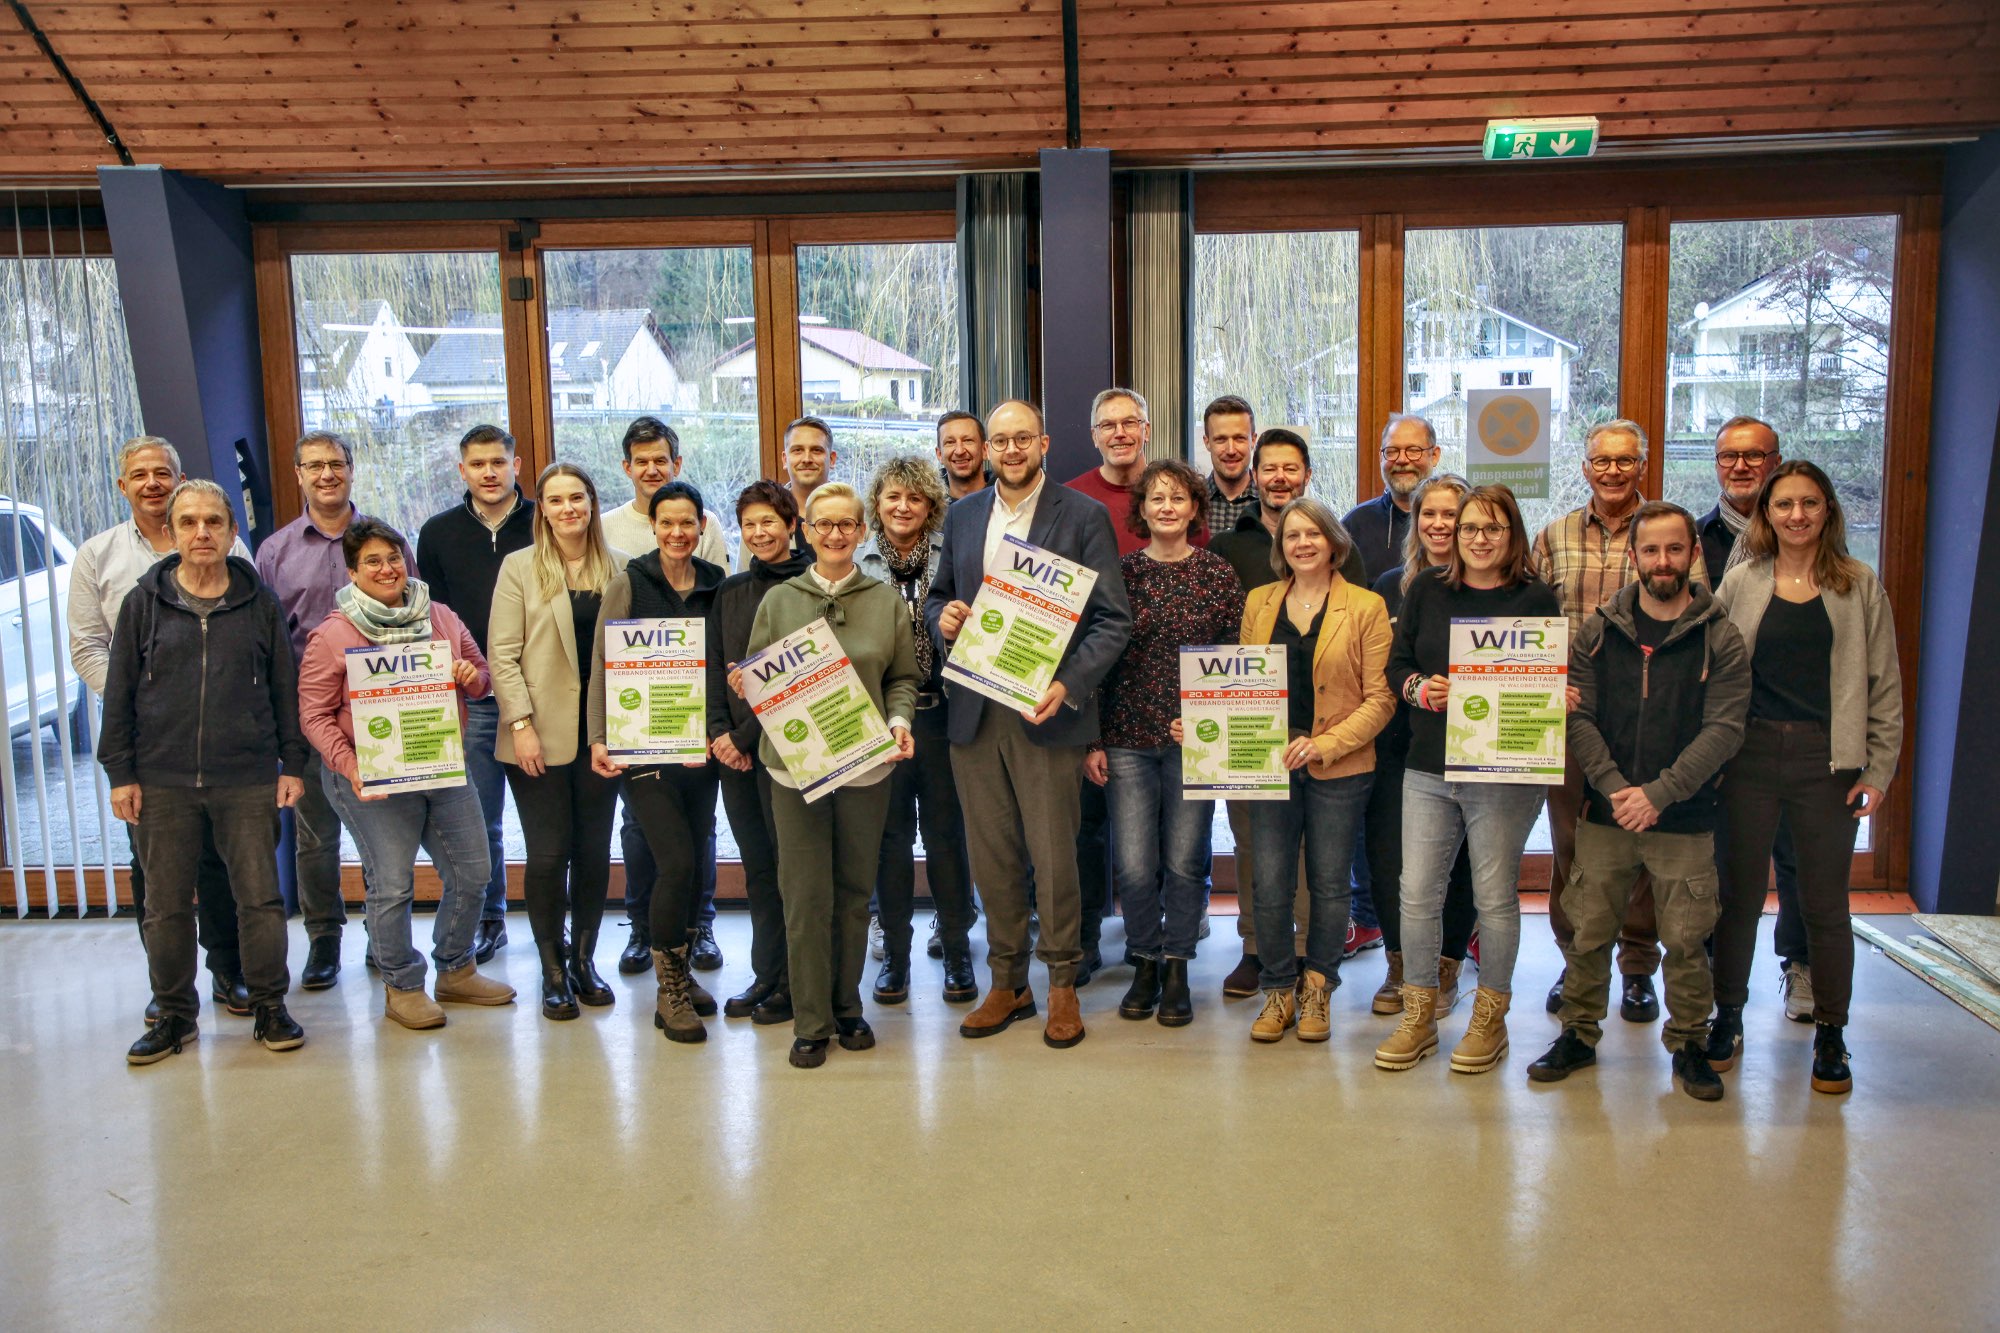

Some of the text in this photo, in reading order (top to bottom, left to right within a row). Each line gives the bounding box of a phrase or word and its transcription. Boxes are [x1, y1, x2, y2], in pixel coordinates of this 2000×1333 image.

[1013, 551, 1074, 593] WIR
[987, 587, 1069, 626] VERBANDSGEMEINDETAGE
[990, 578, 1006, 589] 20.
[1012, 588, 1024, 597] 21.
[1024, 593, 1046, 607] JUNI
[1046, 603, 1073, 618] 2026
[623, 629, 686, 647] WIR
[1470, 630, 1546, 649] WIR
[365, 654, 433, 674] WIR
[752, 639, 820, 683] WIR
[1198, 657, 1267, 676] WIR
[359, 692, 449, 705] VERBANDSGEMEINDETAGE
[760, 698, 776, 710] 20.
[782, 688, 794, 698] 21.
[794, 676, 817, 691] JUNI
[816, 661, 843, 679] 2026
[764, 669, 847, 717] VERBANDSGEMEINDETAGE
